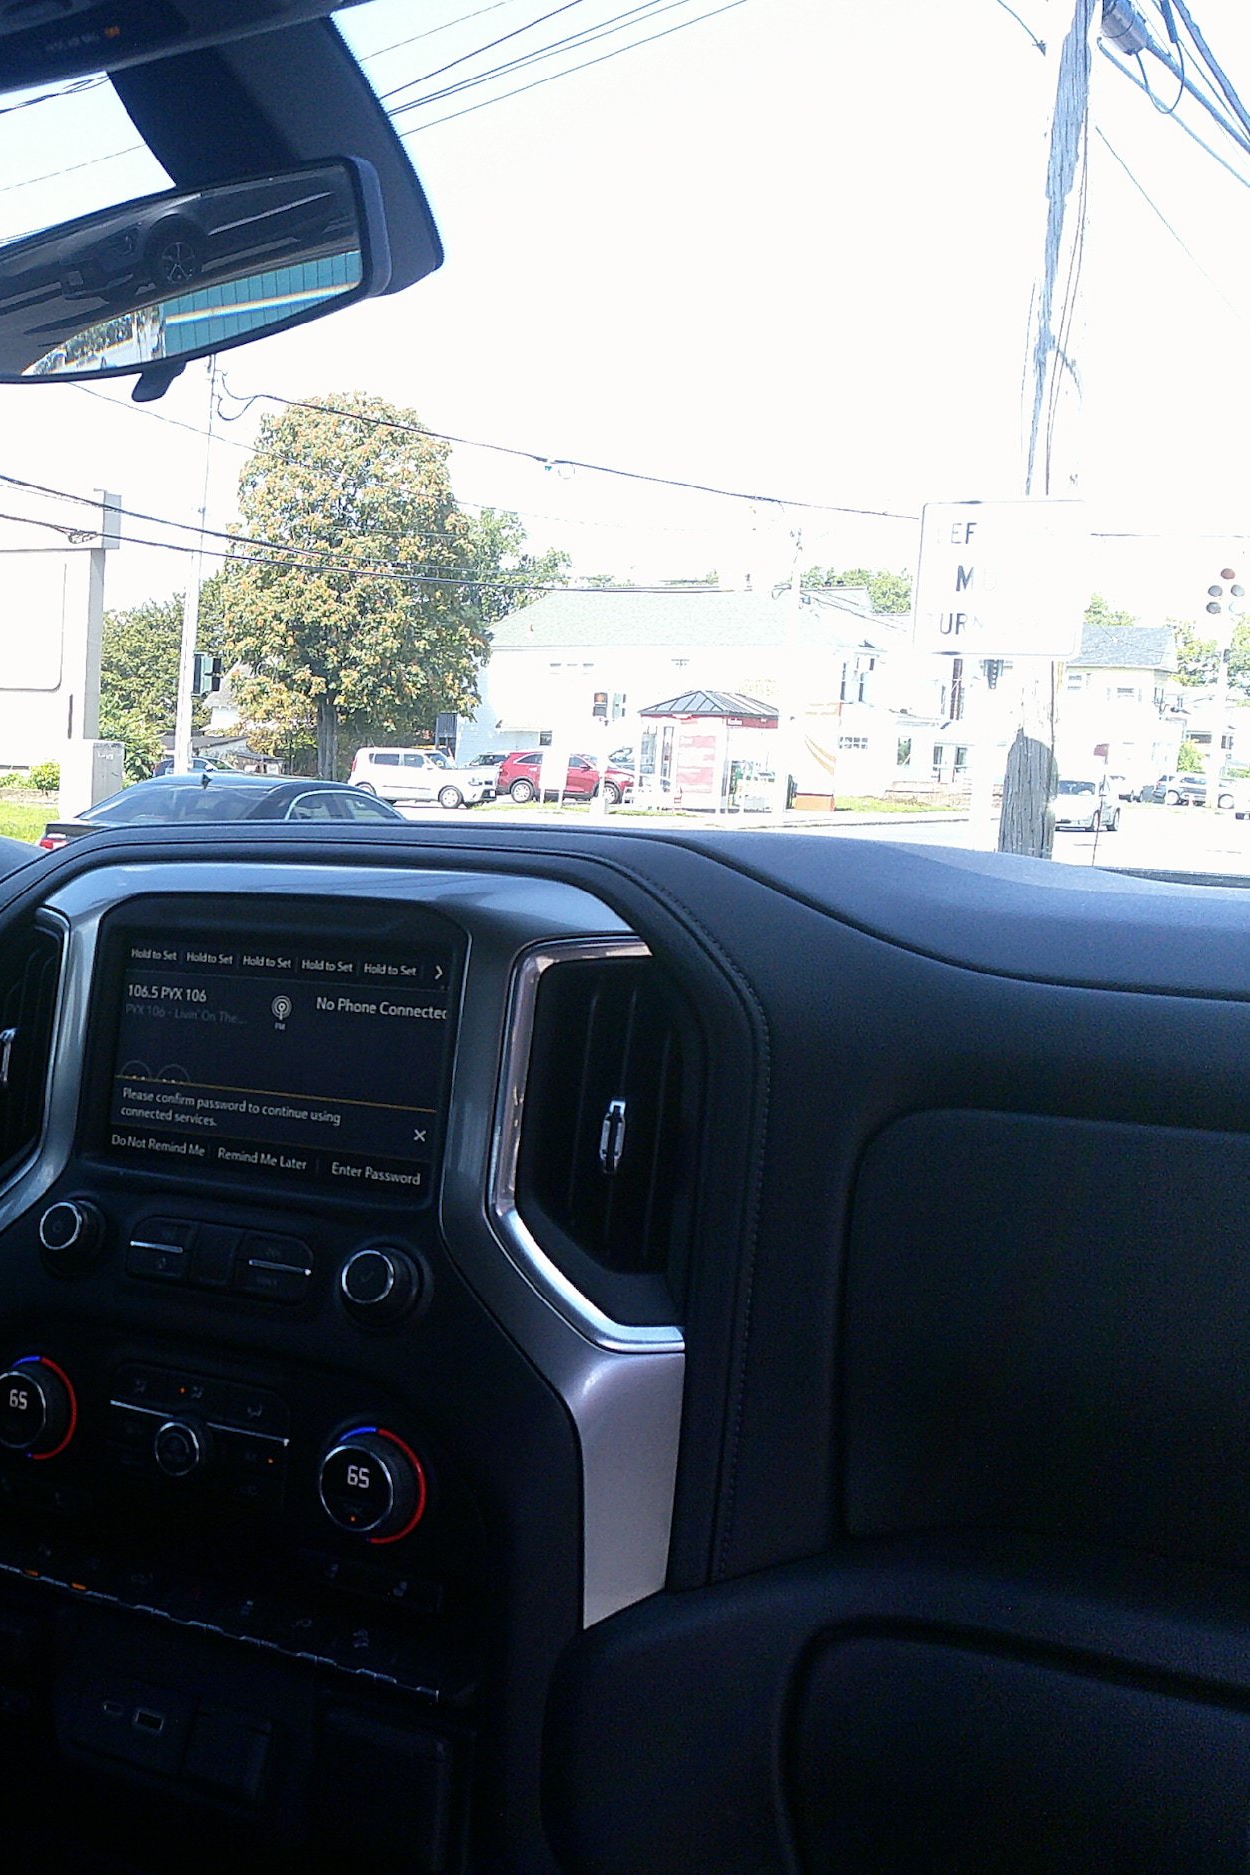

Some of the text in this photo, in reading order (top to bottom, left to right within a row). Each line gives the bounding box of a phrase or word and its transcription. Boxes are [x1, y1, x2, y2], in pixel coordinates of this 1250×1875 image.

[131, 948, 177, 961] Hold to Set
[186, 952, 233, 964] Hold to Set
[242, 956, 292, 969] Hold to Set
[301, 960, 353, 973] Hold to Set
[364, 963, 417, 976] Hold to Set
[128, 984, 207, 1002] 106.5 PYX 106
[316, 997, 335, 1011] No
[337, 998, 377, 1014] Phone
[120, 1105, 218, 1128] connected services.
[122, 1086, 341, 1127] Please confirm password to continue using
[111, 1133, 205, 1156] Do Not Remind Me
[218, 1147, 307, 1171] Remind Me Later
[331, 1161, 421, 1186] Enter Password
[9, 1388, 29, 1411] 65
[347, 1464, 370, 1489] 65
